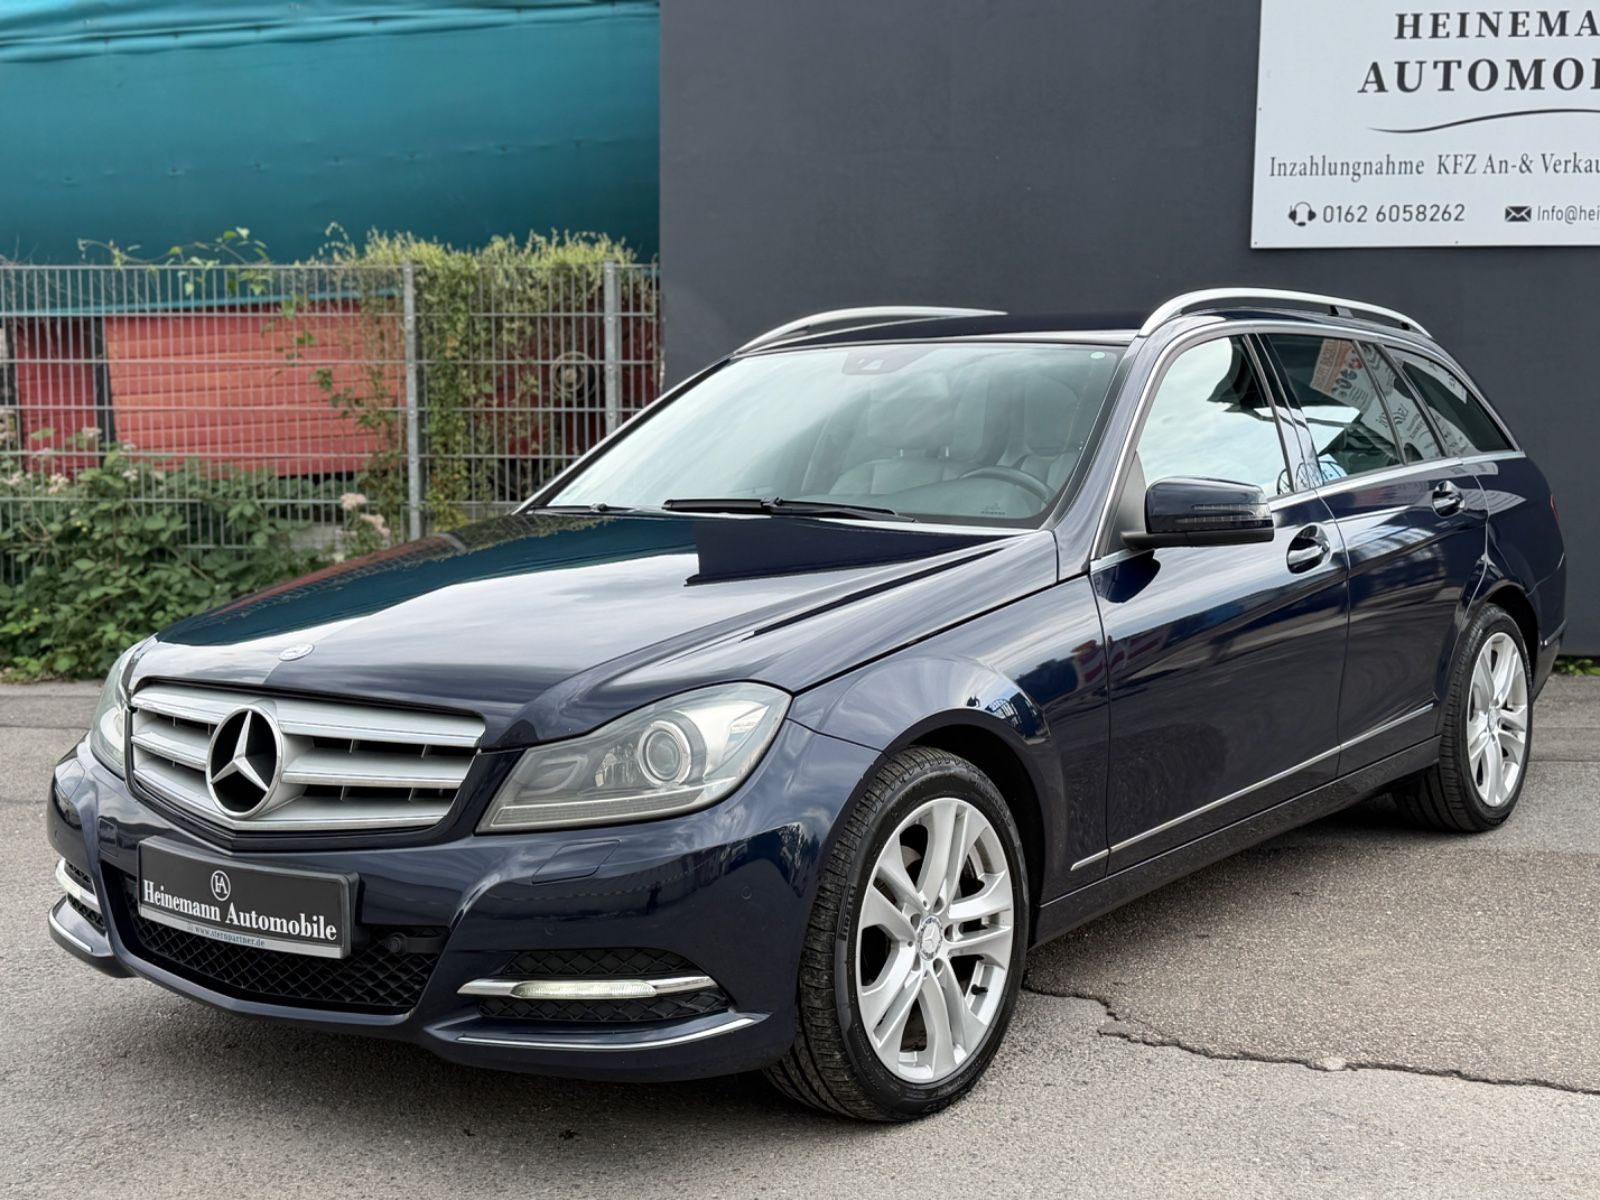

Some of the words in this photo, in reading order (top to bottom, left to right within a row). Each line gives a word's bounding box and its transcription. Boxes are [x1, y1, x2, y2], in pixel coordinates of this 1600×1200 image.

[1394, 10, 1600, 39] HEINEMA
[1269, 154, 1425, 183] Inzahlungnahme
[1436, 153, 1477, 175] KFZ
[1322, 204, 1368, 223] 0162
[1375, 203, 1465, 223] 6058262
[143, 880, 221, 922] Heinemann
[225, 902, 337, 941] Automobile
